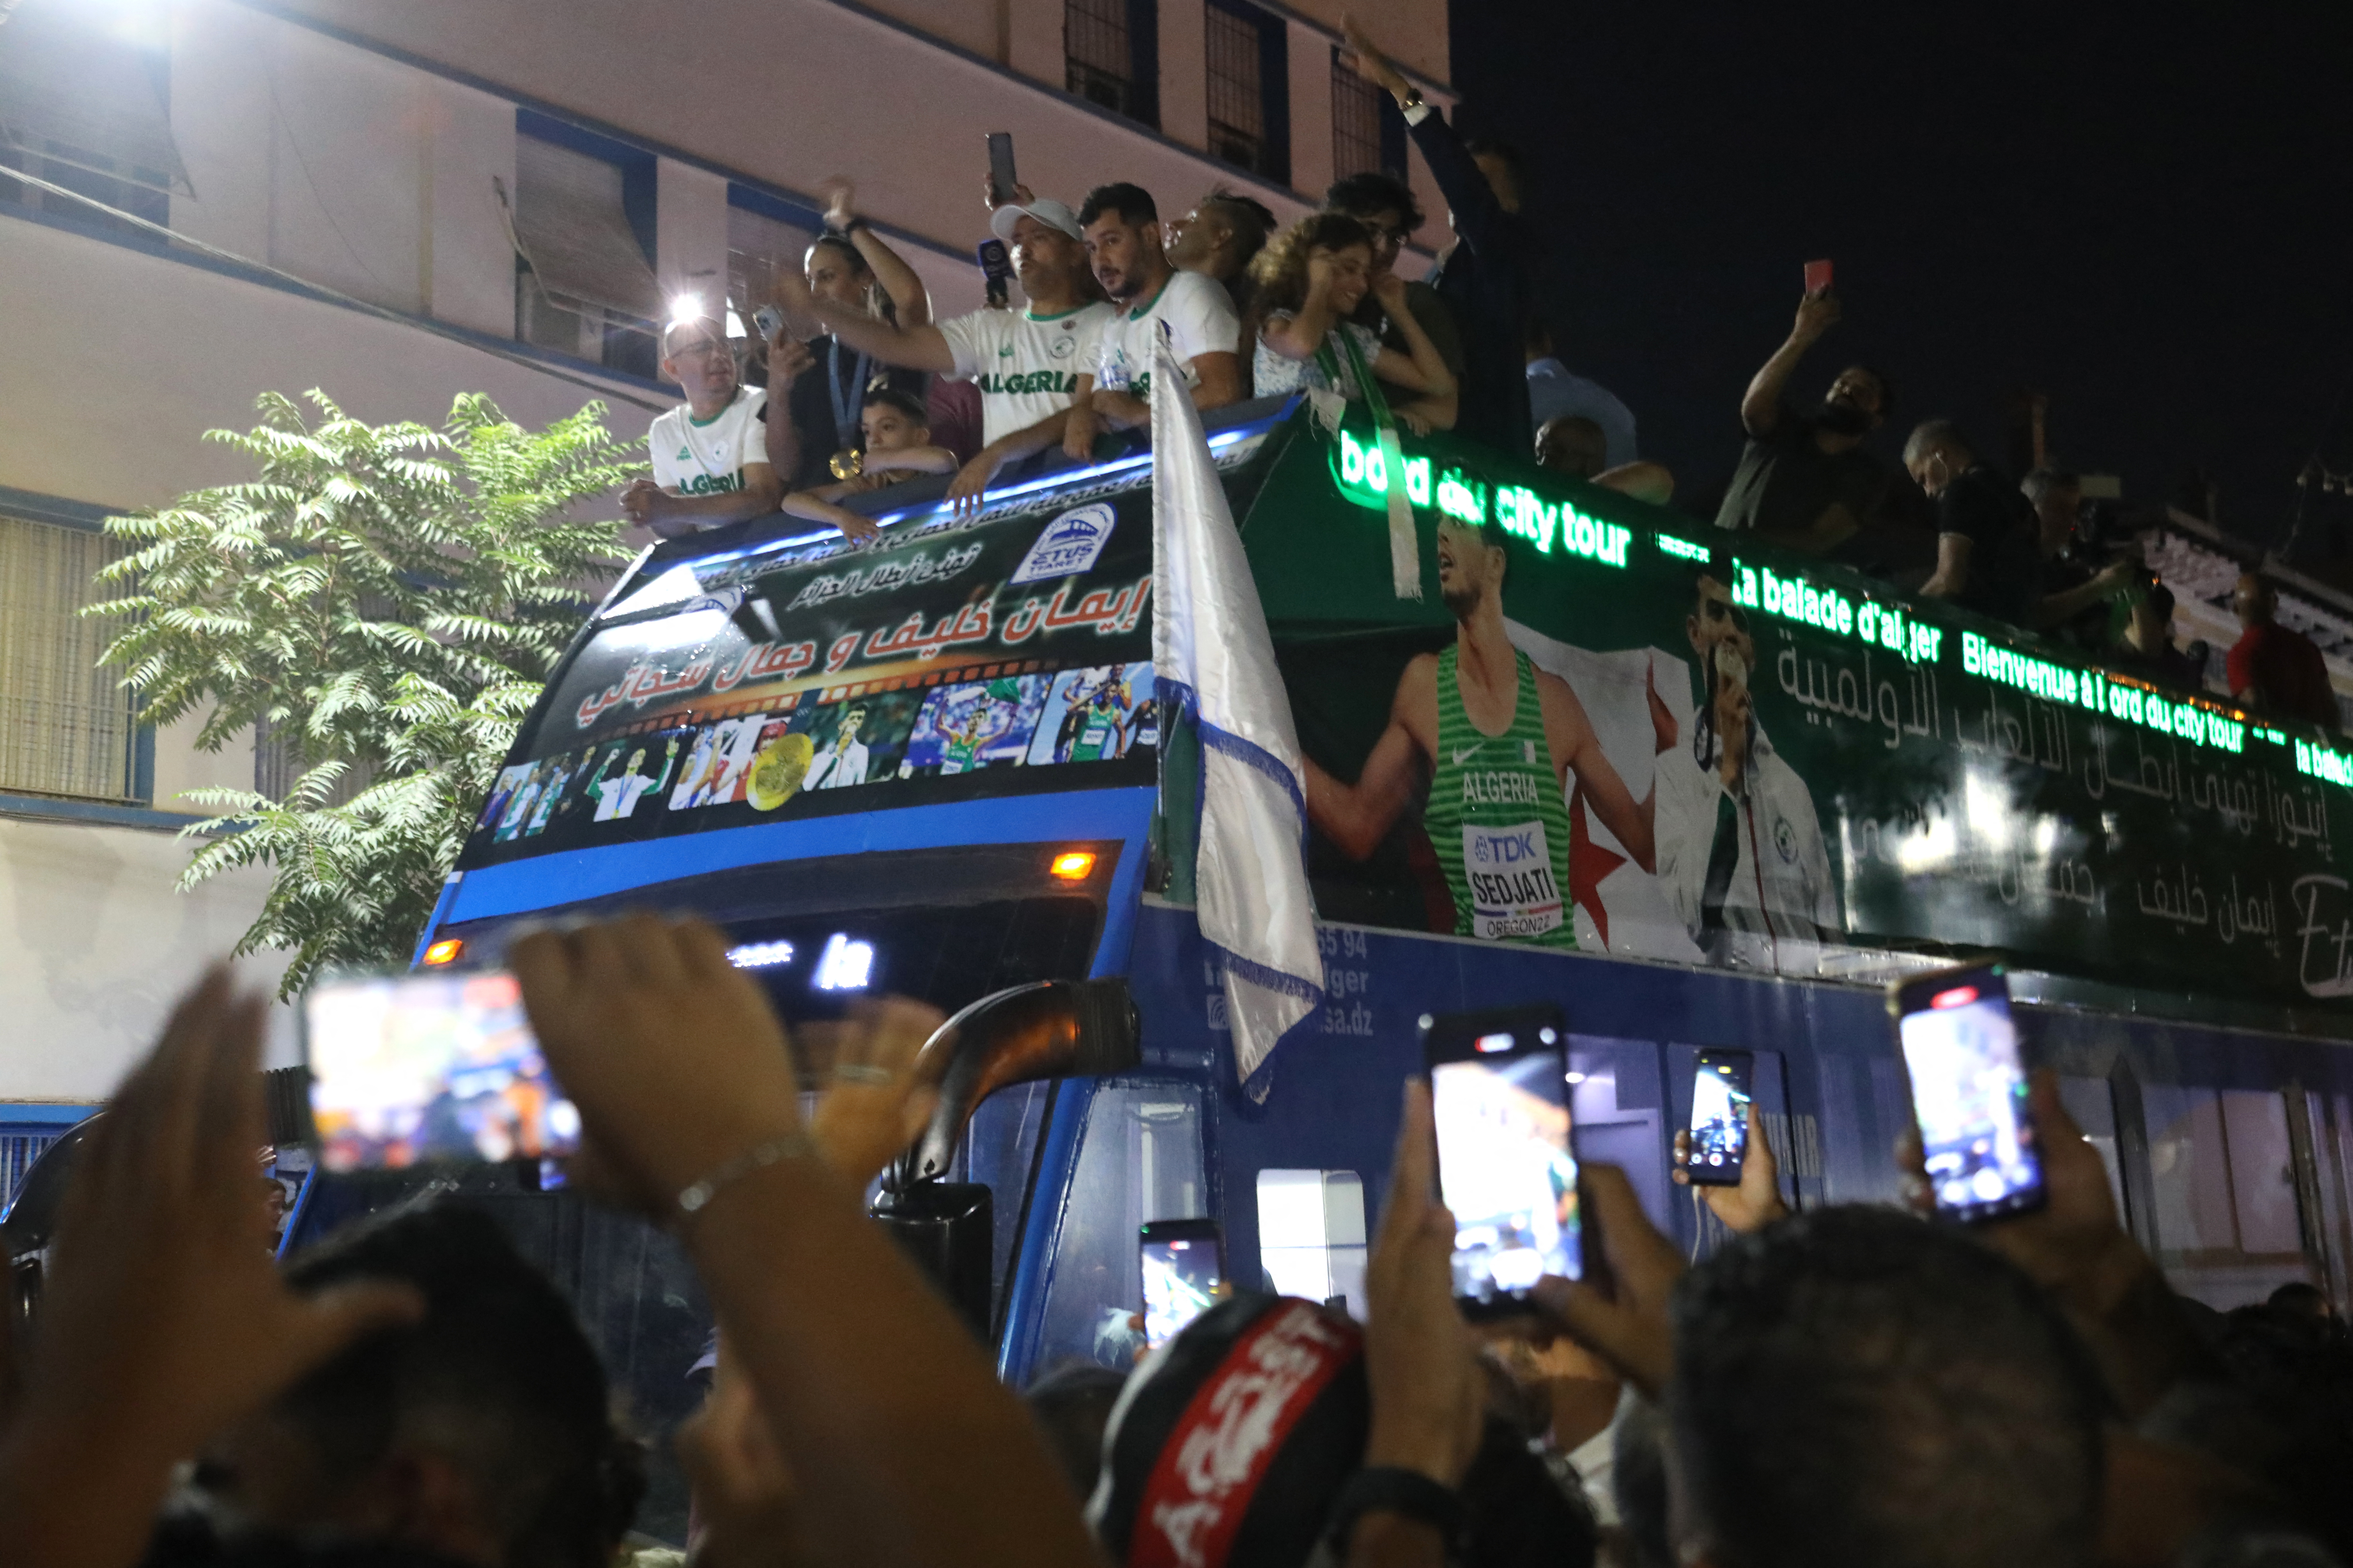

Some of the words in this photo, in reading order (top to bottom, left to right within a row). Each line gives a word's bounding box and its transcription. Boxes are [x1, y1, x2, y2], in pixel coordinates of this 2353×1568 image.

[1341, 429, 1430, 507] bod
[1495, 485, 1558, 554] city
[1561, 501, 1632, 569] tour
[864, 600, 992, 660] خليف
[1000, 574, 1153, 646] إيمان
[712, 638, 817, 692] جمال
[824, 631, 863, 675] و
[1762, 566, 1853, 636] balade
[1962, 630, 2078, 704] Bienvenue
[2146, 693, 2172, 733] du
[2174, 703, 2205, 747] city
[2207, 711, 2245, 753] tour
[2295, 737, 2312, 775] la
[576, 658, 714, 729] سجاتي
[1463, 771, 1539, 805] ALGERIA
[1488, 832, 1536, 864] TDK
[1472, 867, 1555, 905] SEDJATI
[2137, 863, 2208, 936] خليف
[1343, 929, 1367, 959] 94
[1487, 915, 1550, 937] OREGON22
[2219, 873, 2281, 959] إيمان
[2291, 873, 2353, 997] Et
[1323, 959, 1369, 998] lger
